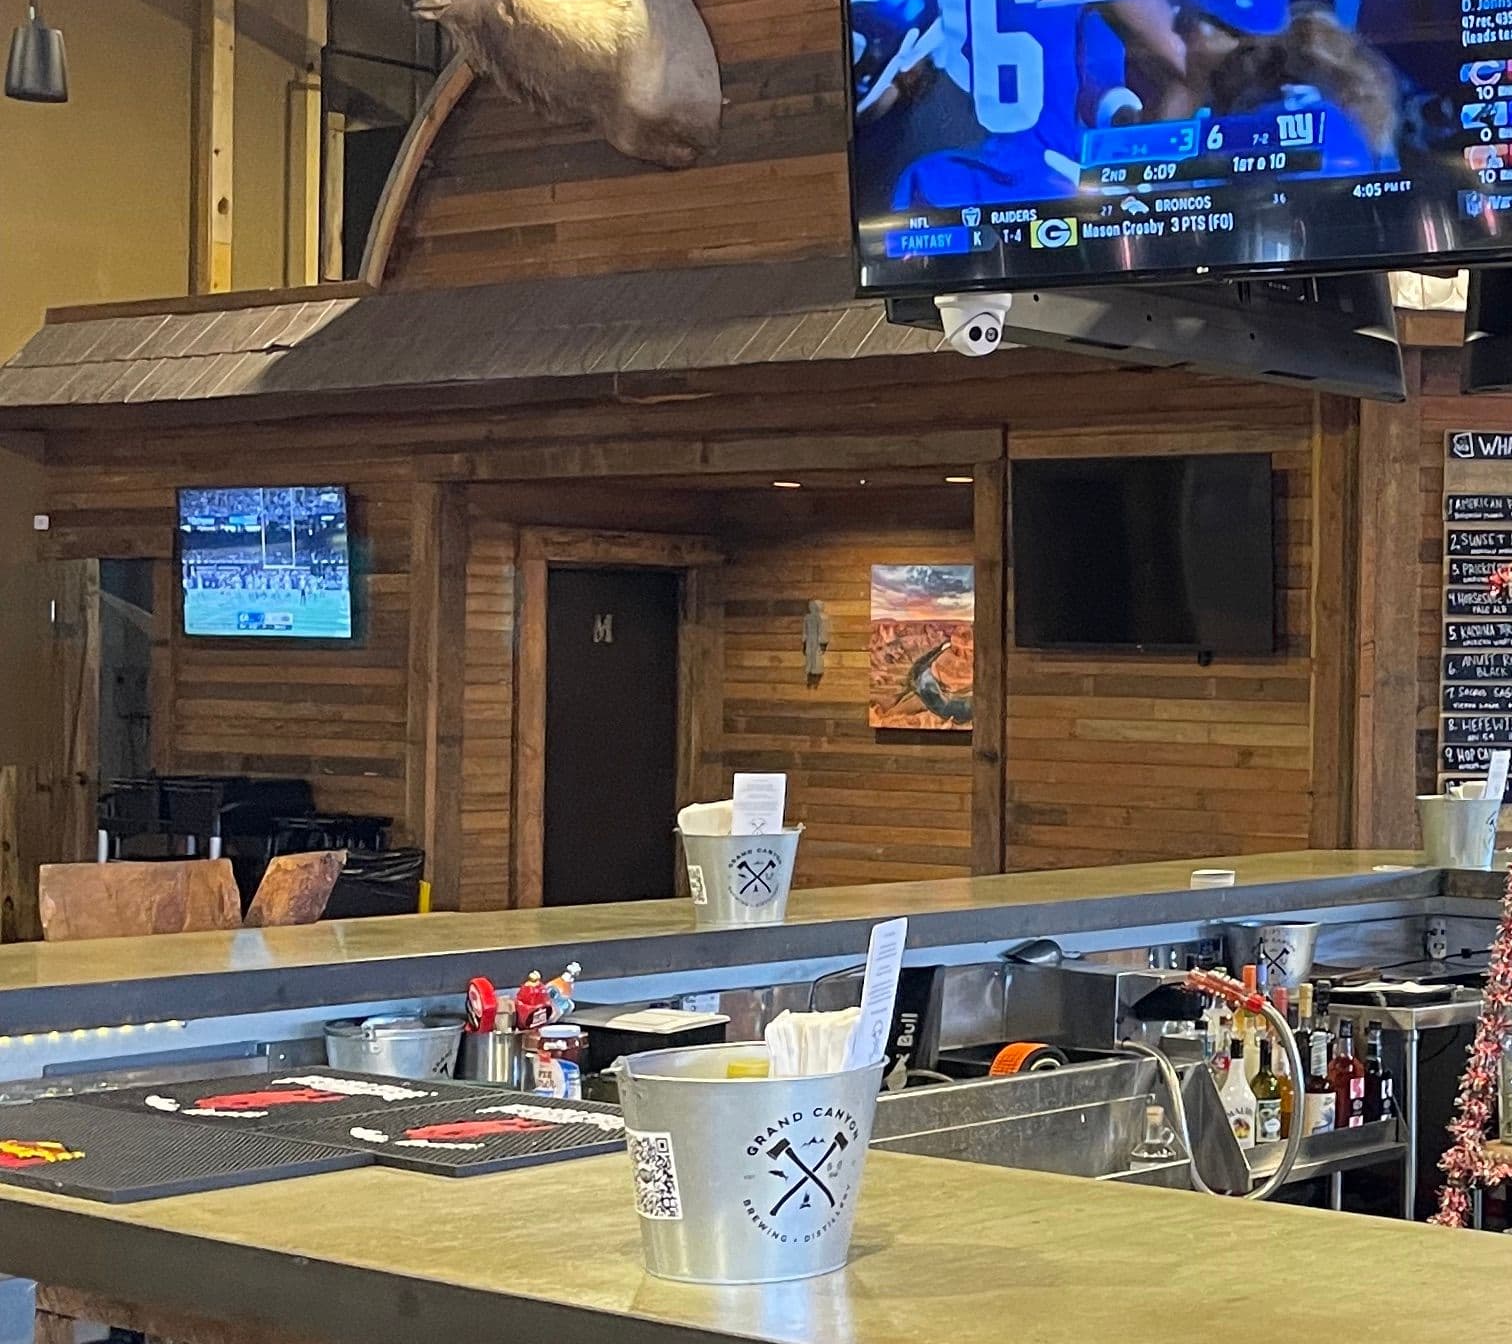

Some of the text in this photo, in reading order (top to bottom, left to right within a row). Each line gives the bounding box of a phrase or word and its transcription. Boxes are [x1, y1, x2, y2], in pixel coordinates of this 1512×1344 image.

[1462, 28, 1496, 47] (leads
[1476, 86, 1494, 100] 10
[1207, 124, 1224, 150] 6
[1480, 127, 1492, 142] 0
[1101, 168, 1127, 182] 2ND
[1143, 164, 1176, 181] 6:09
[1269, 152, 1287, 170] 10
[1479, 169, 1496, 184] 10
[1353, 183, 1382, 198] 4:05
[1155, 196, 1212, 213] BRONCOS
[909, 217, 930, 230] NFL
[991, 209, 1038, 225] RAIDERS
[973, 233, 982, 247] K
[1082, 221, 1120, 239] Mason
[1123, 219, 1164, 237] Crosby
[1170, 218, 1180, 233] 3
[1181, 215, 1206, 232] PTS
[901, 233, 952, 251] FANTASY
[747, 1107, 859, 1156] GRAND CANYON
[743, 1199, 787, 1243] BREWING
